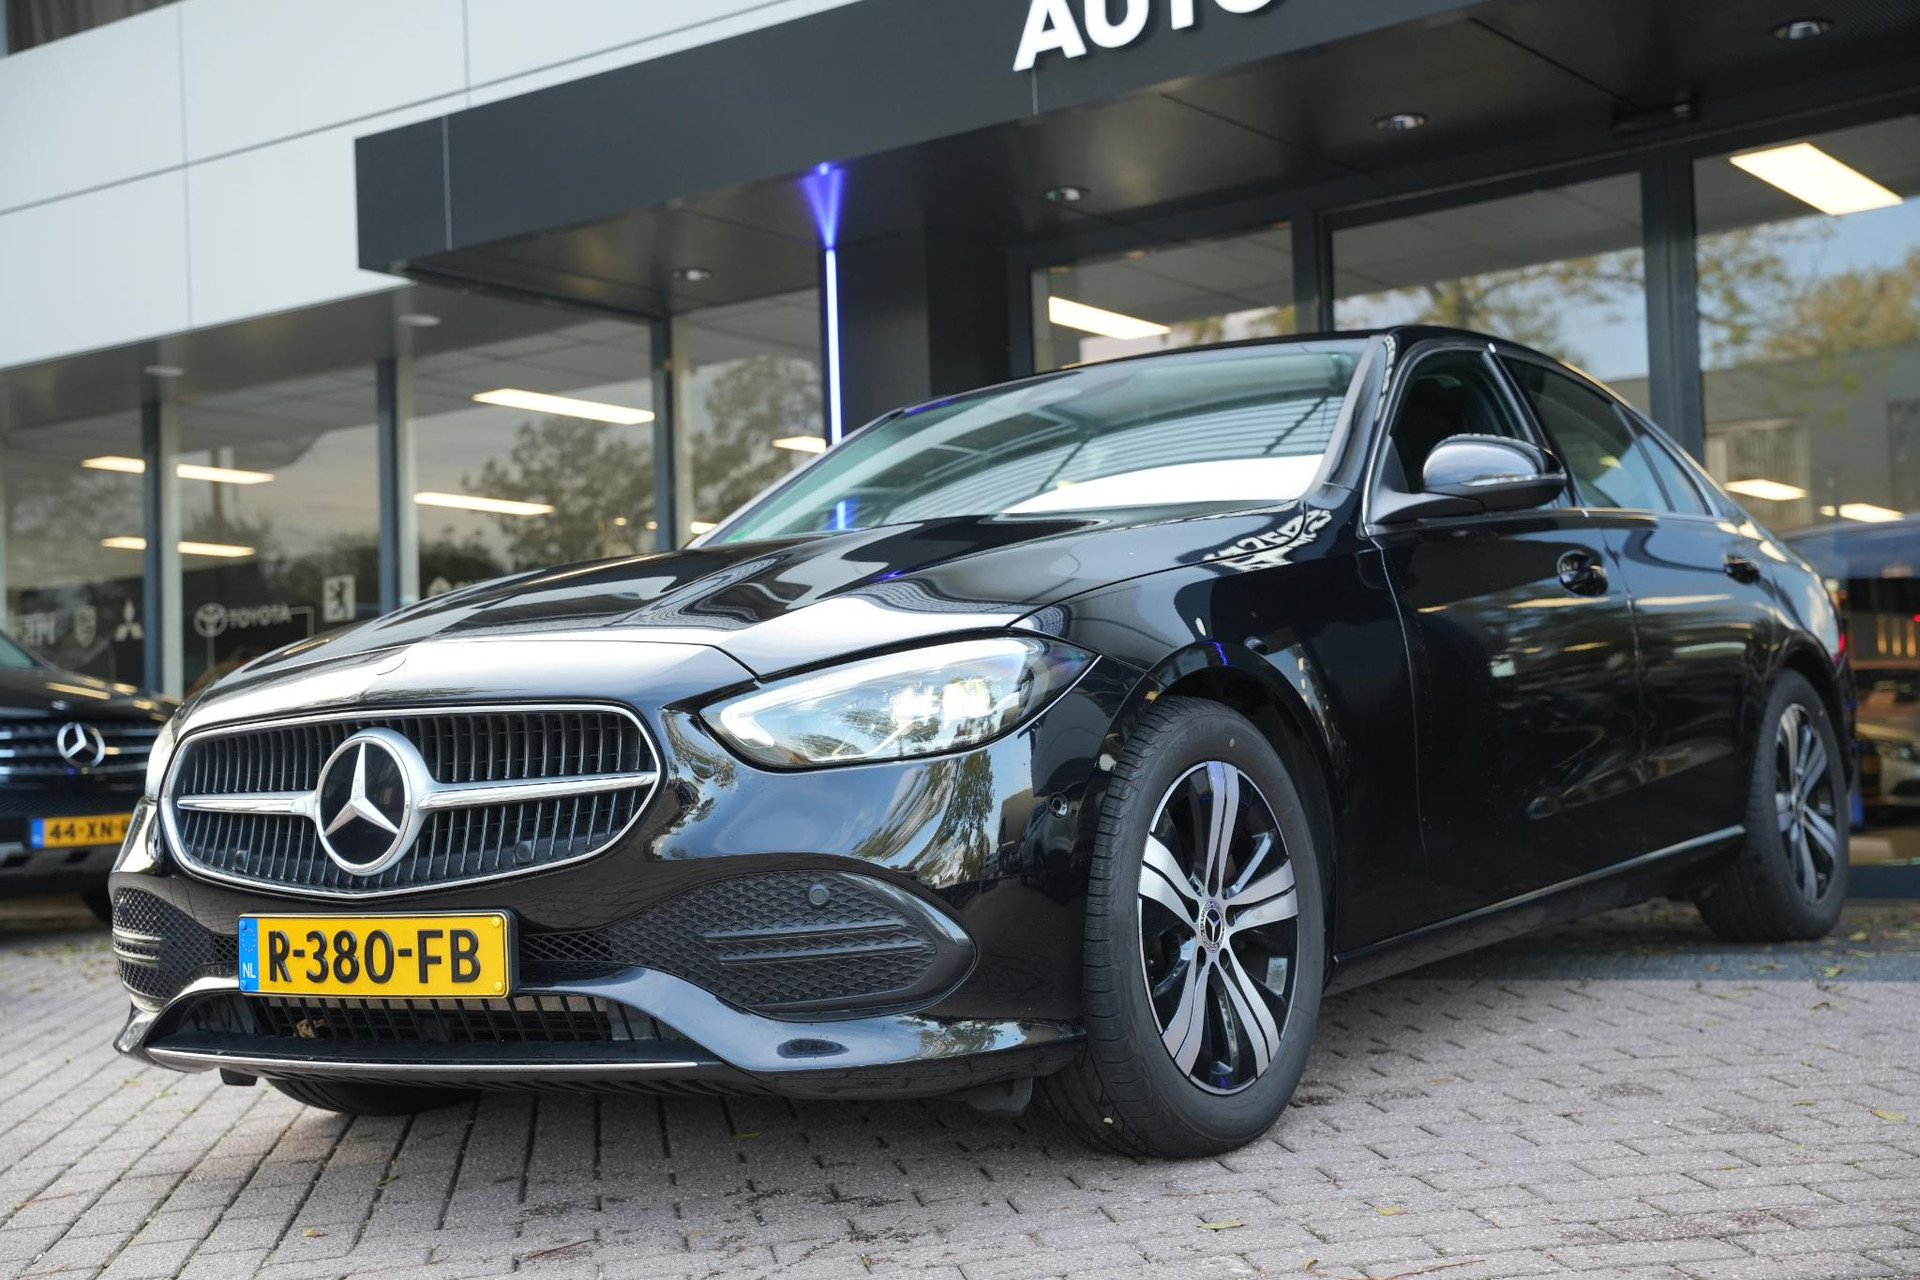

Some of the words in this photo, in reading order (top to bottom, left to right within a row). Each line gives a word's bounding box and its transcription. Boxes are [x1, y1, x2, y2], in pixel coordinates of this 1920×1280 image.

[1012, 0, 1277, 72] AU
[228, 604, 292, 629] TOYOTA
[242, 962, 257, 979] NL
[268, 929, 481, 984] R-380-FB
